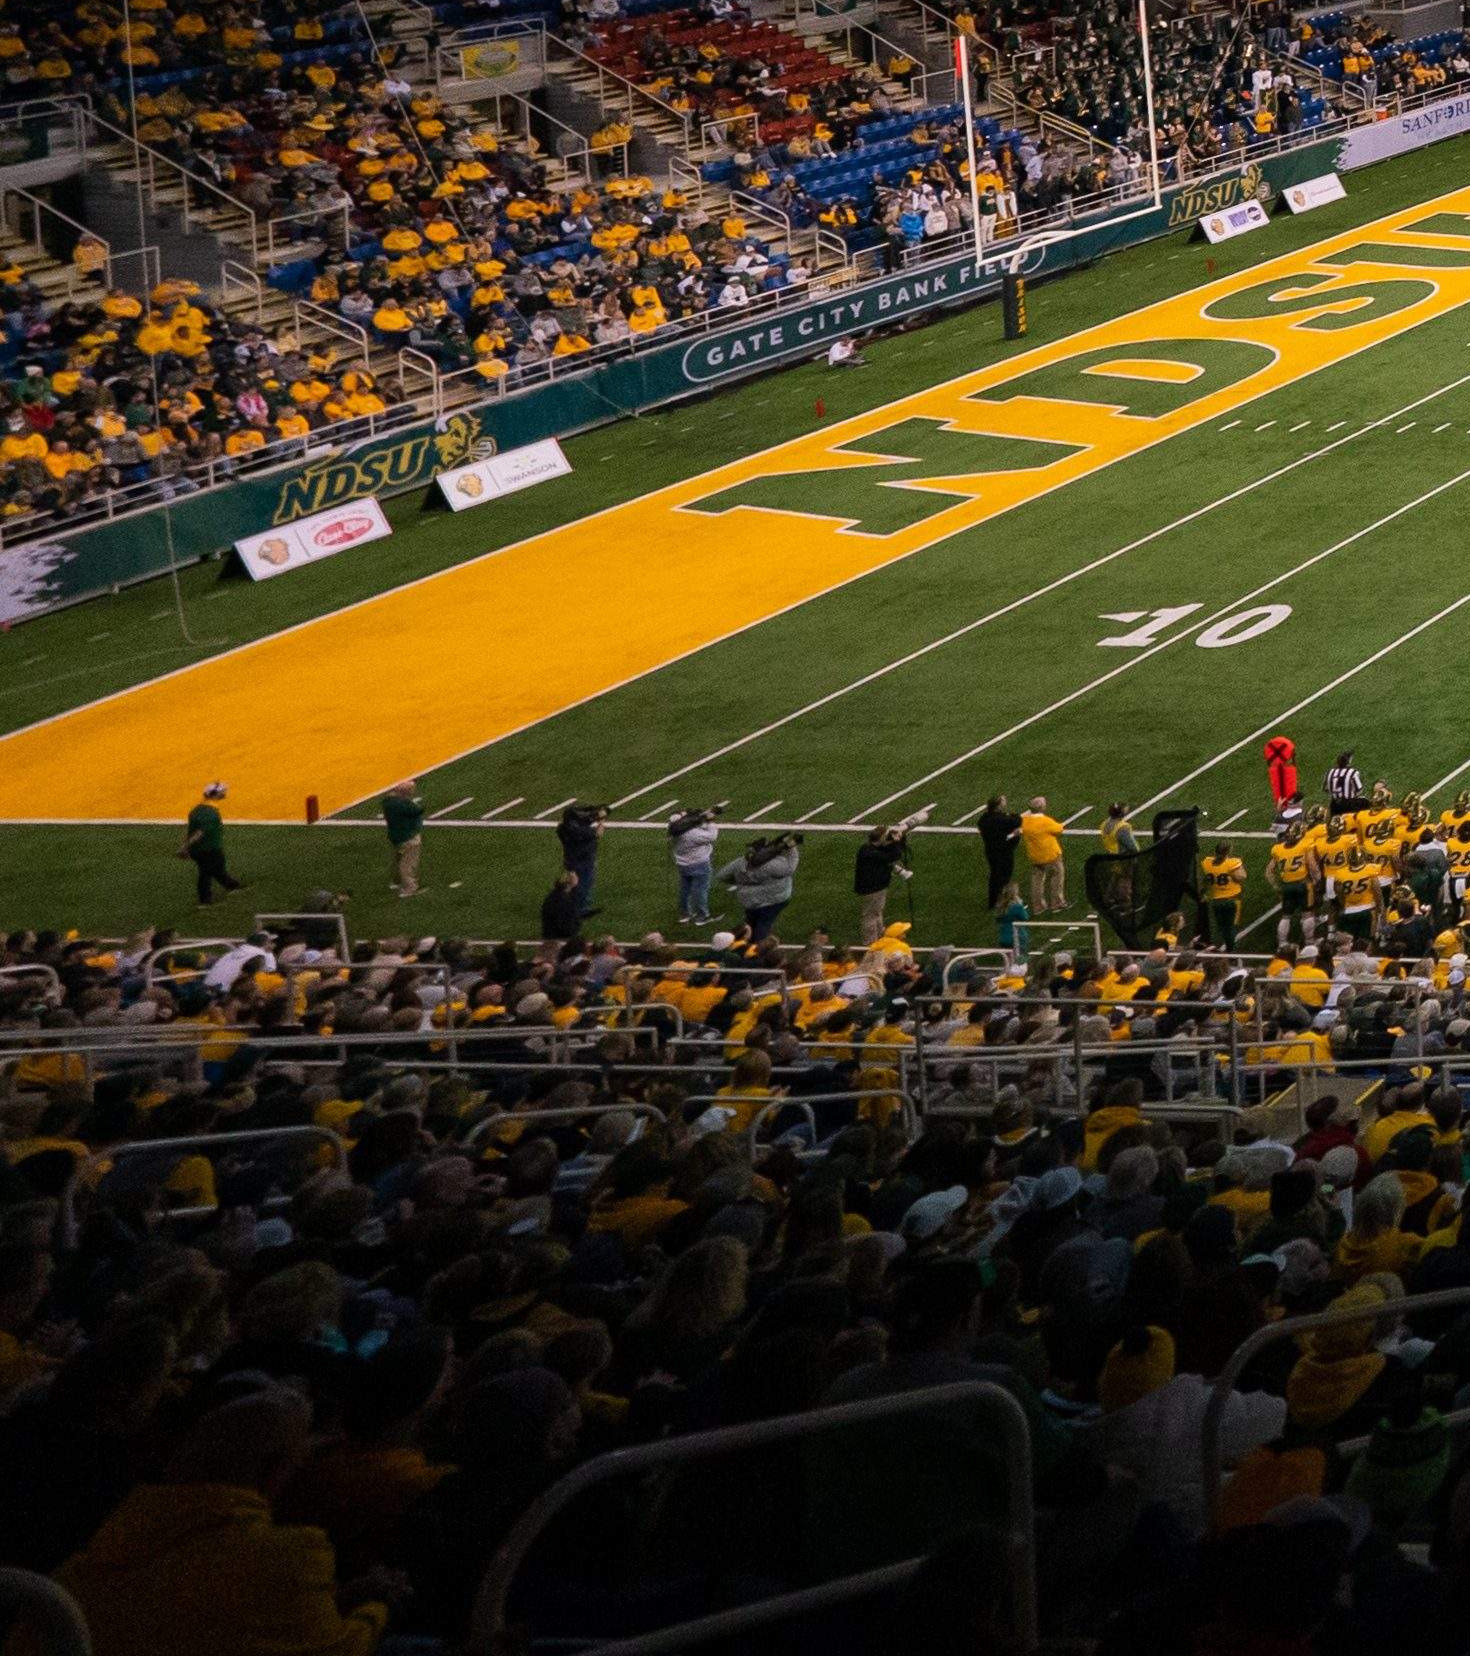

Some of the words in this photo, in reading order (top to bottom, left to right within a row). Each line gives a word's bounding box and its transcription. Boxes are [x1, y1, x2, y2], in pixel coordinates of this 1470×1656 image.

[1169, 176, 1241, 227] NDSU
[706, 326, 784, 366] GATE
[797, 300, 864, 337] CITY
[877, 274, 948, 311] BANK
[273, 437, 430, 525] NDSU
[1098, 602, 1294, 650] 10
